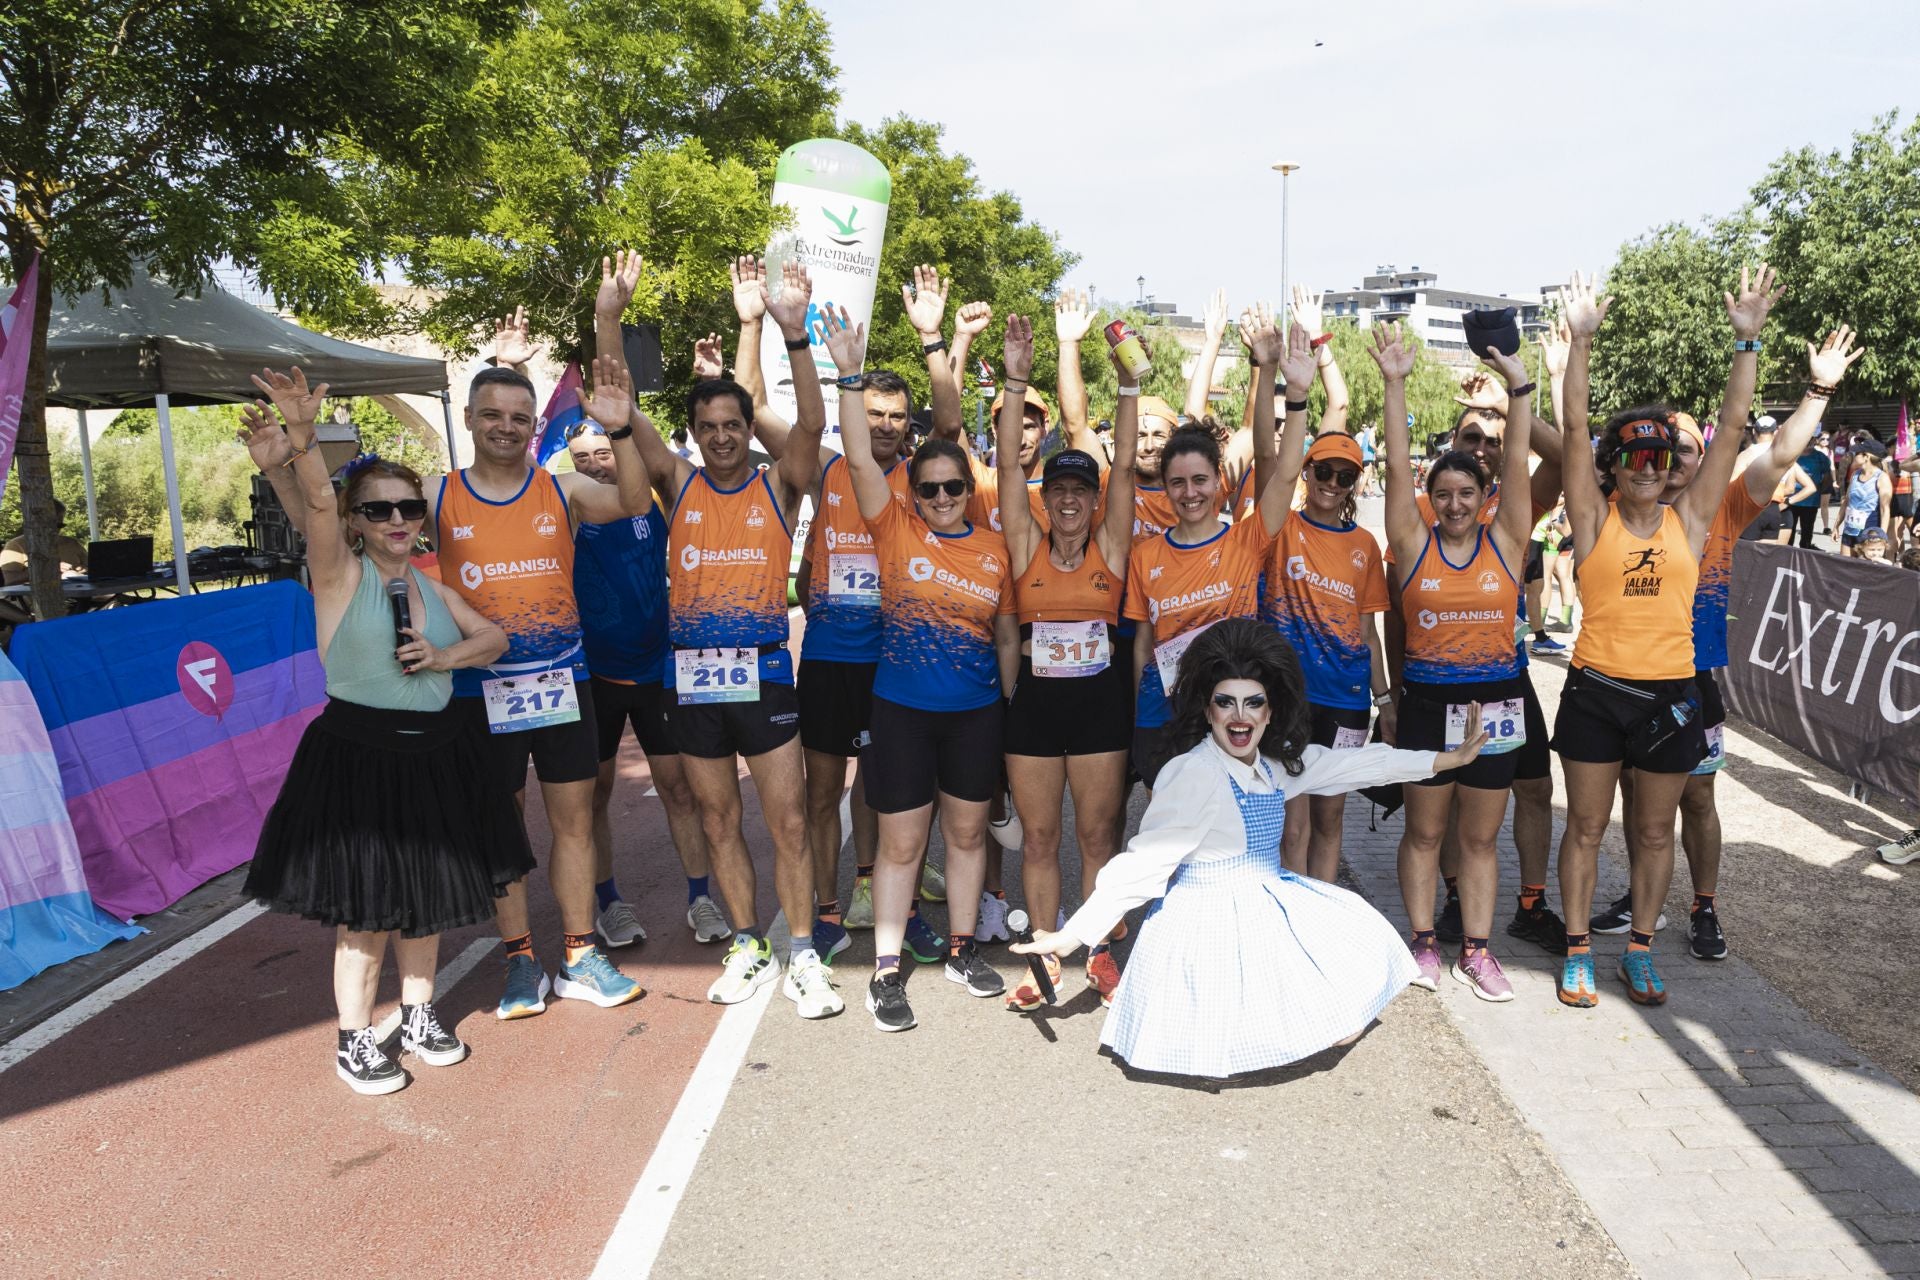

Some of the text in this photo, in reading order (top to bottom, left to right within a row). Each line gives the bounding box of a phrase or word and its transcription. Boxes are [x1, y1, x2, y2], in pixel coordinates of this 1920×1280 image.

[795, 239, 876, 268] Extremadura
[452, 525, 475, 539] DK
[701, 548, 768, 561] GRANISUL
[483, 558, 560, 577] GRANISUL
[843, 571, 881, 589] 12
[1420, 578, 1443, 589] DK
[1159, 580, 1233, 611] GRANISUL
[1622, 588, 1660, 597] RUNNING
[1438, 610, 1505, 621] GRANISUL
[1049, 640, 1100, 661] 317
[1749, 566, 1920, 725] Extre
[693, 667, 749, 687] 216
[505, 689, 565, 715] 217
[1484, 718, 1515, 738] 18
